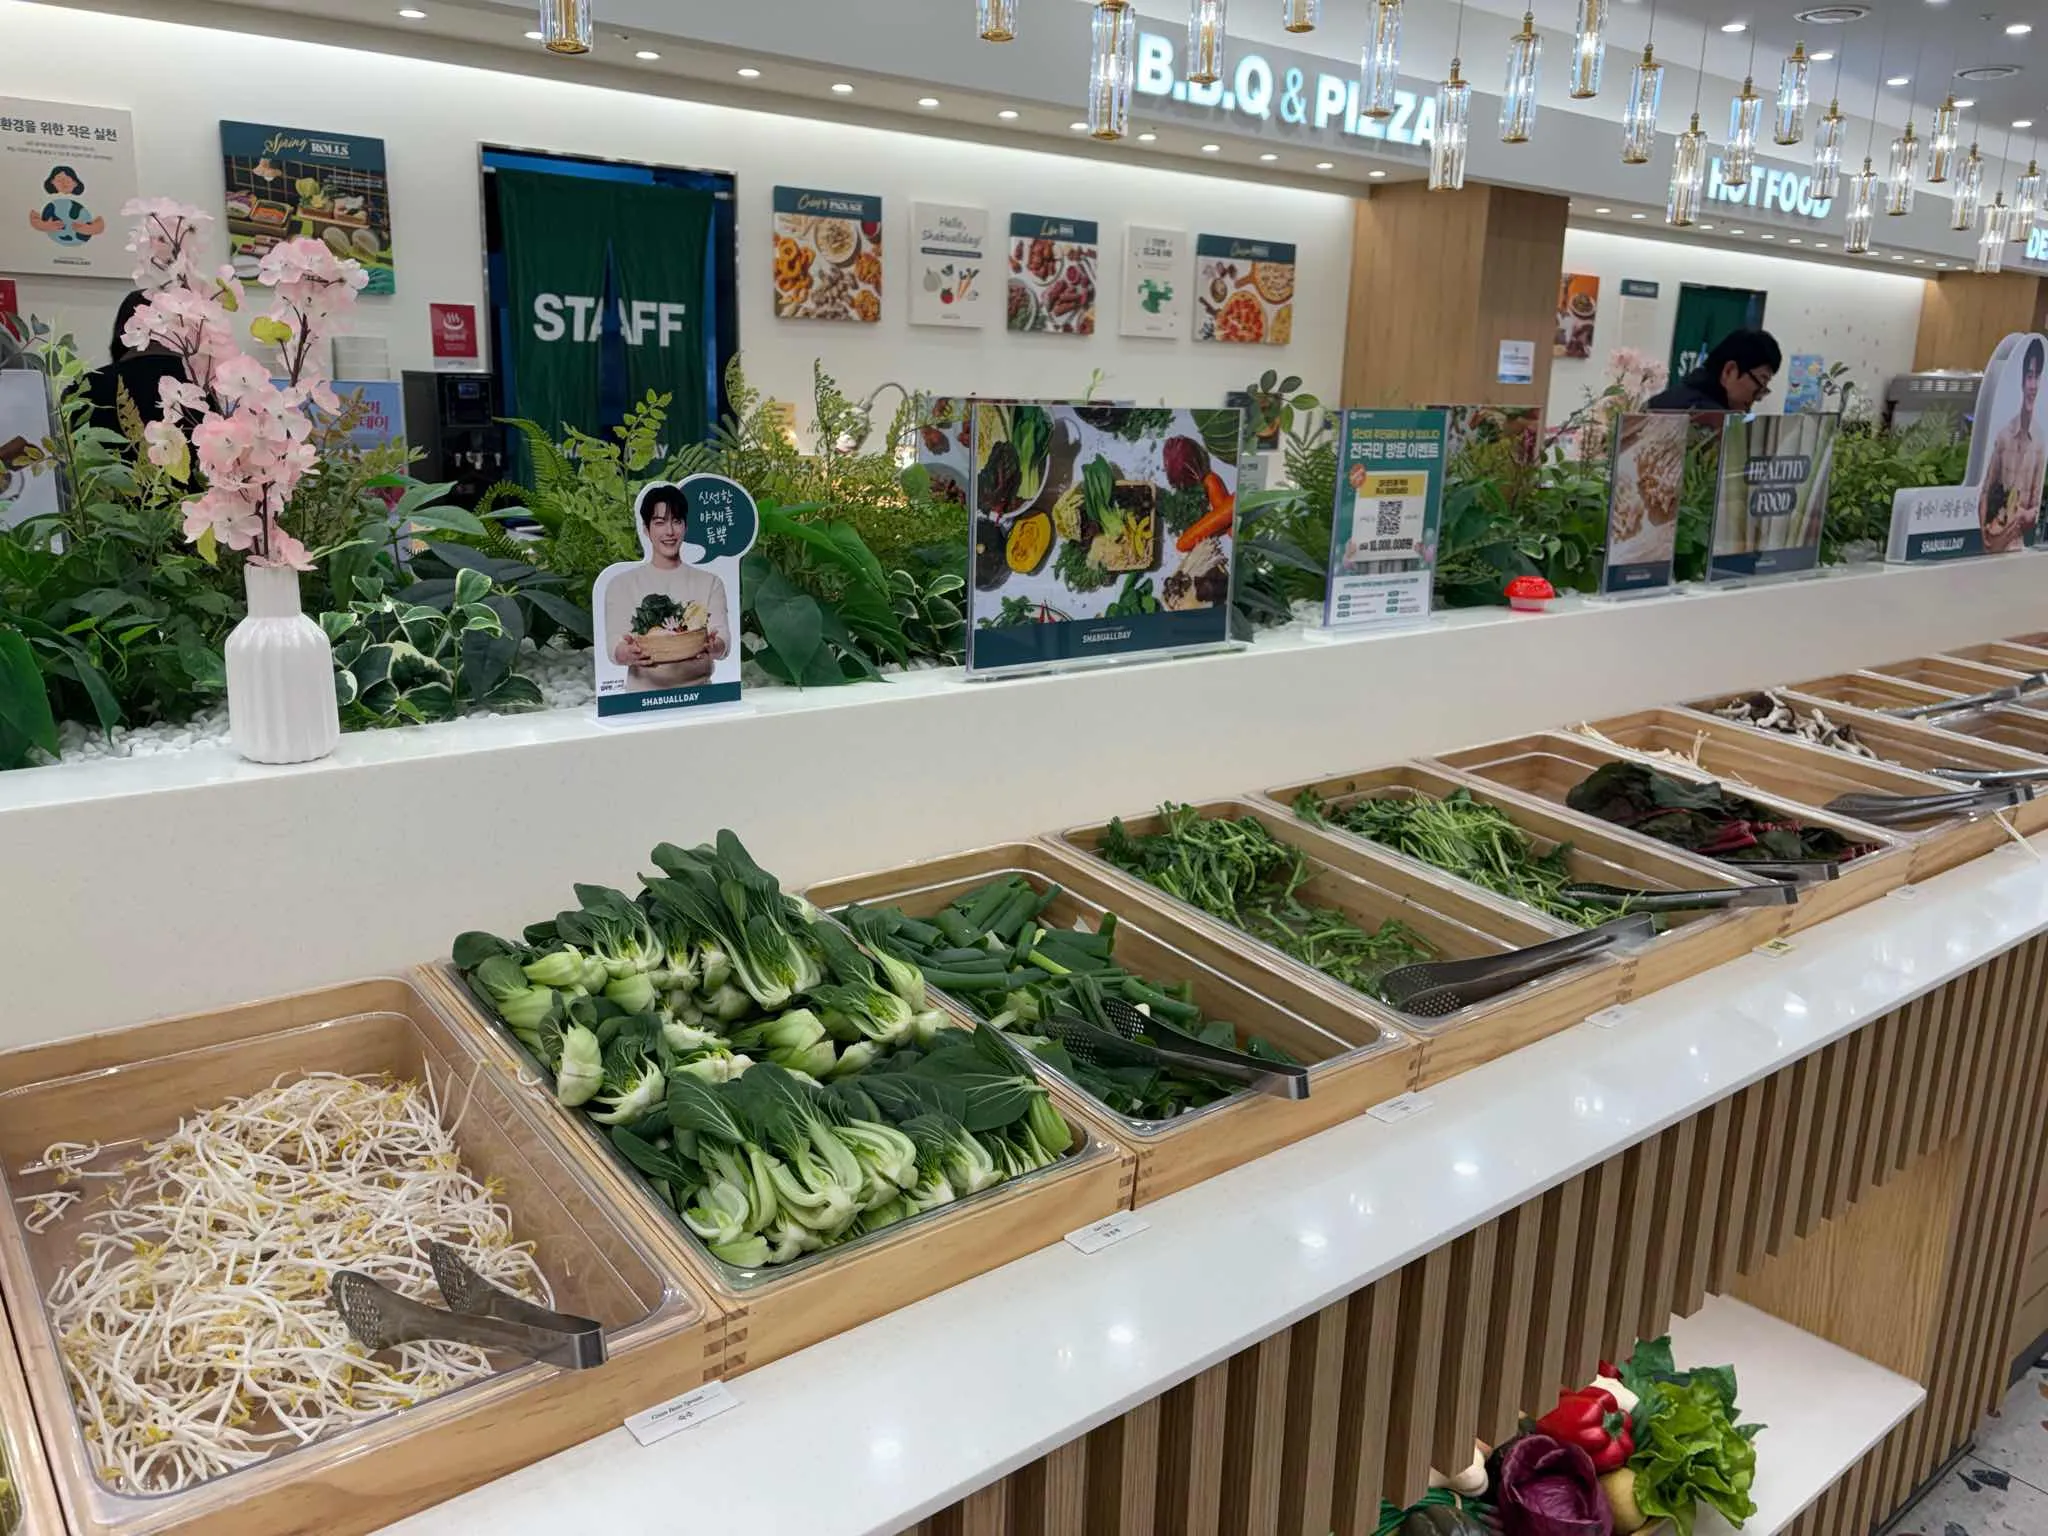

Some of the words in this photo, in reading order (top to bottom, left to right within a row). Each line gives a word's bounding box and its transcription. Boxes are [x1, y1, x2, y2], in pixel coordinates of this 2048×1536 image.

[1280, 67, 1307, 124] &
[1315, 73, 1437, 146] PIZA
[0, 117, 36, 133] 환경을
[41, 122, 64, 136] 위한
[67, 124, 91, 139] 작은
[94, 127, 118, 142] 실천
[263, 132, 308, 155] Spring
[311, 142, 349, 156] ROLLS
[533, 294, 686, 347] STAFF
[1749, 460, 1805, 481] HEALTHY
[699, 489, 733, 505] 신선한
[1756, 491, 1792, 513] FOOD
[700, 506, 735, 526] 야채를
[706, 527, 728, 545] 듬뿍
[1082, 630, 1132, 644] SHABUALLDAY
[641, 692, 700, 707] SHABUALLDAY
